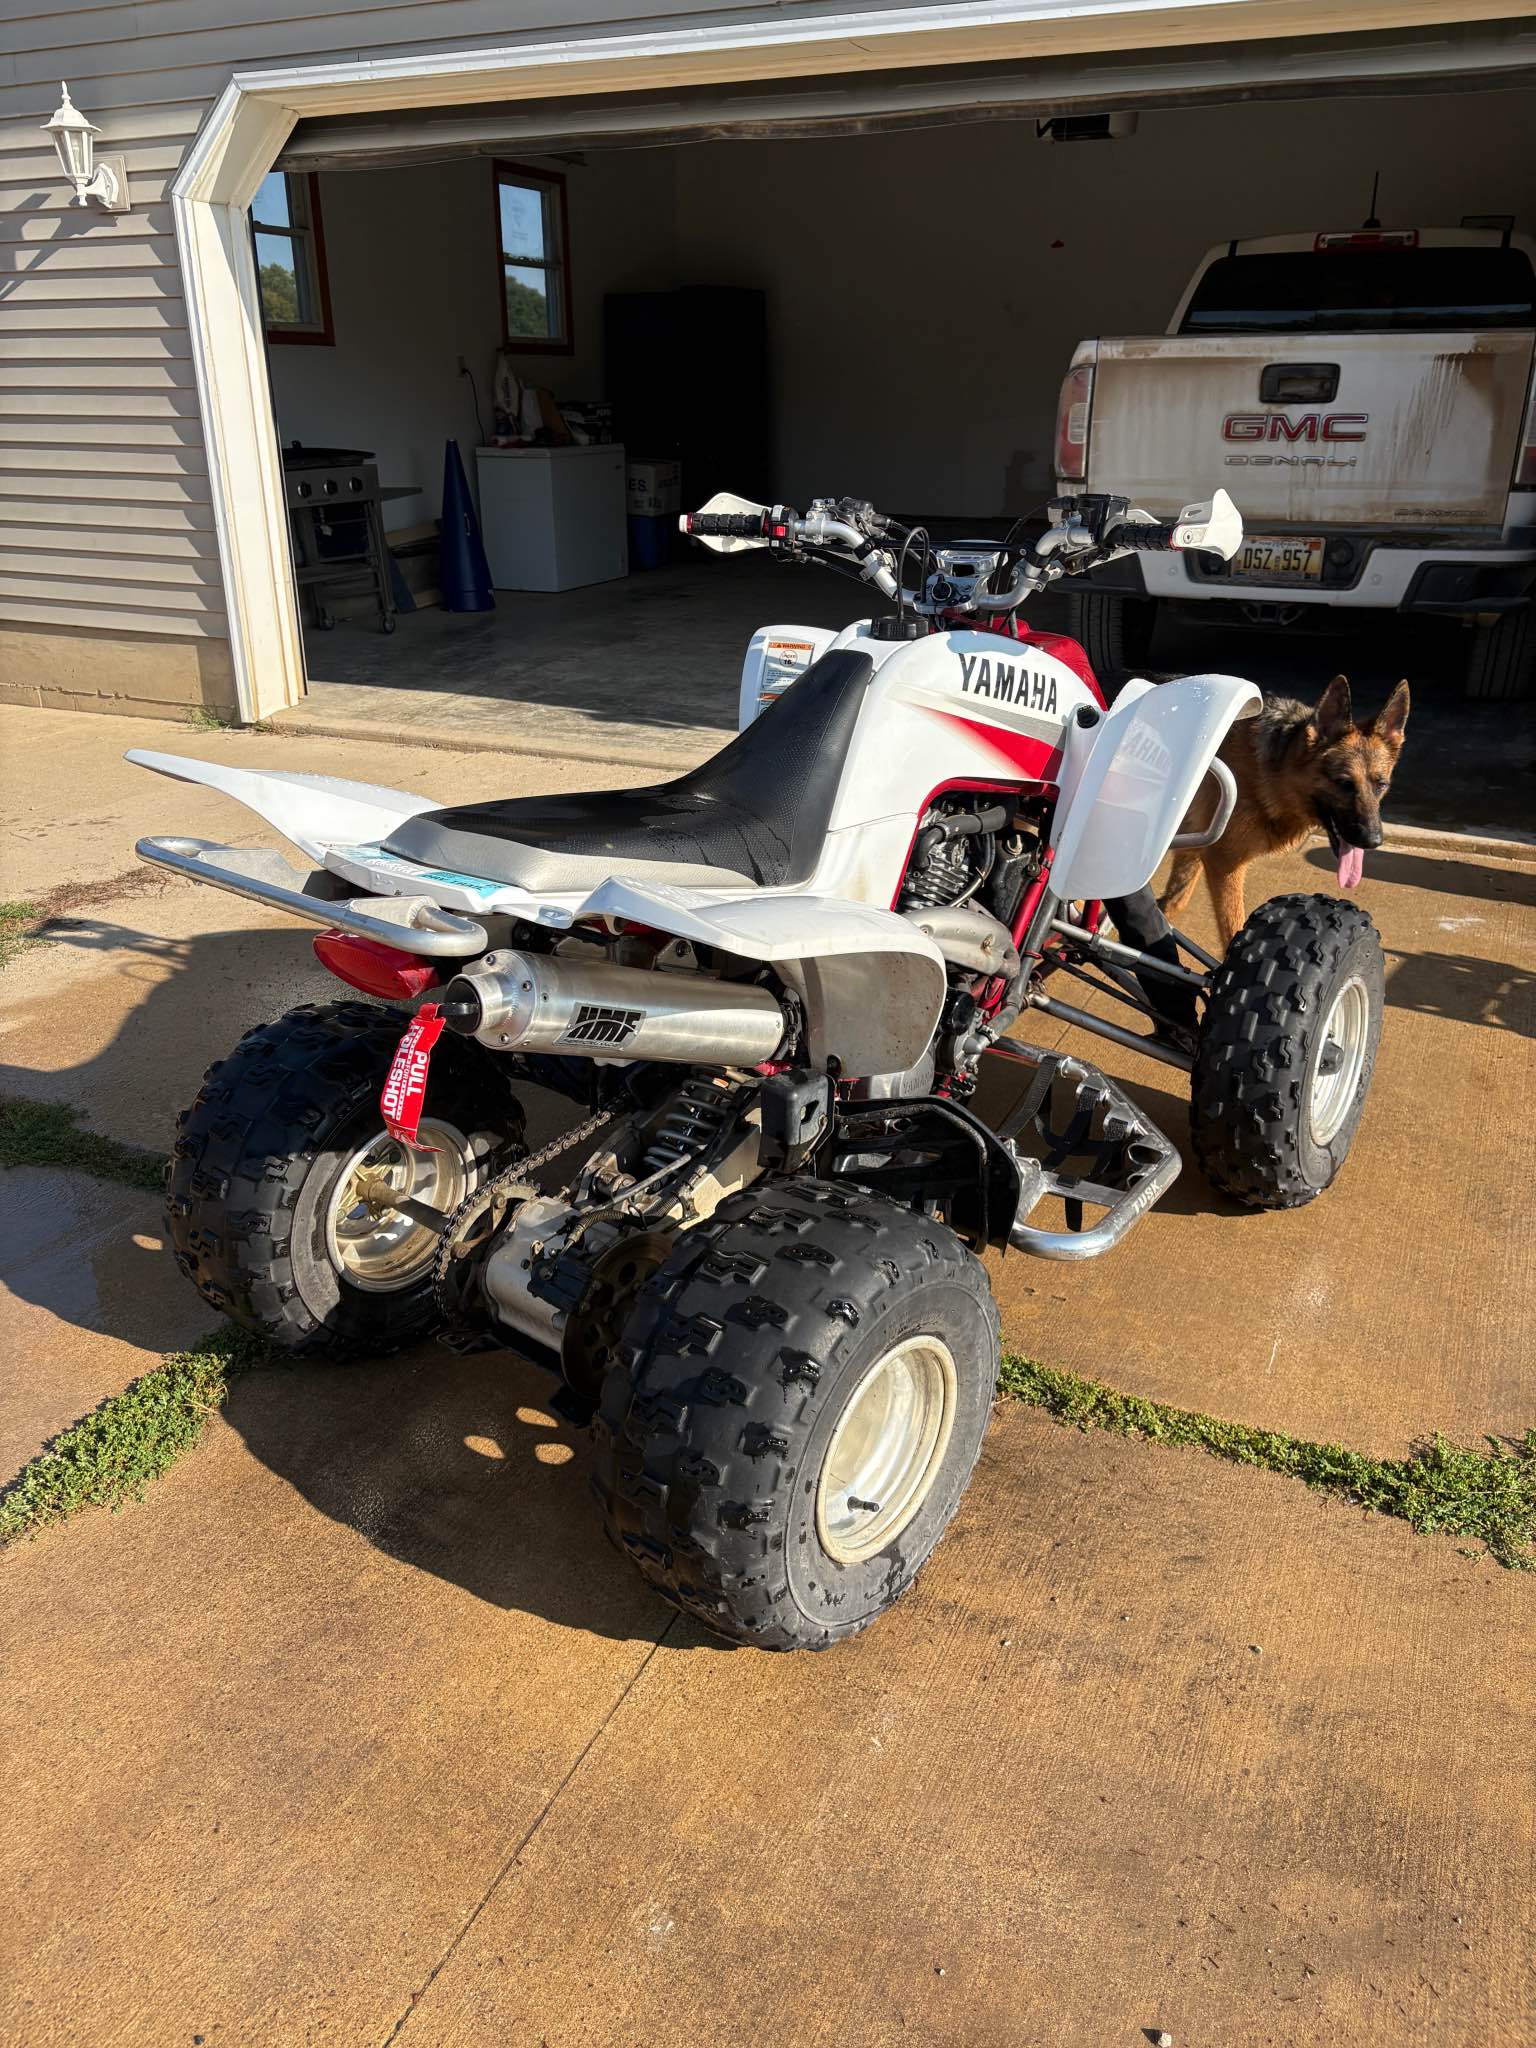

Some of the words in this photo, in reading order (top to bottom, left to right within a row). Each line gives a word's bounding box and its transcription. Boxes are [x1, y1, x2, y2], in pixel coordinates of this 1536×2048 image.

[1223, 413, 1368, 442] GMC
[1224, 455, 1357, 467] DENALI
[1243, 547, 1273, 570] DSZ
[1282, 549, 1312, 572] 957
[958, 653, 1057, 715] YAMAHA
[567, 1006, 642, 1042] HMF
[383, 1024, 420, 1119] HOLESHOT
[403, 1063, 412, 1080] FOR
[406, 1050, 428, 1097] PULL
[1131, 1179, 1161, 1215] TUSK
